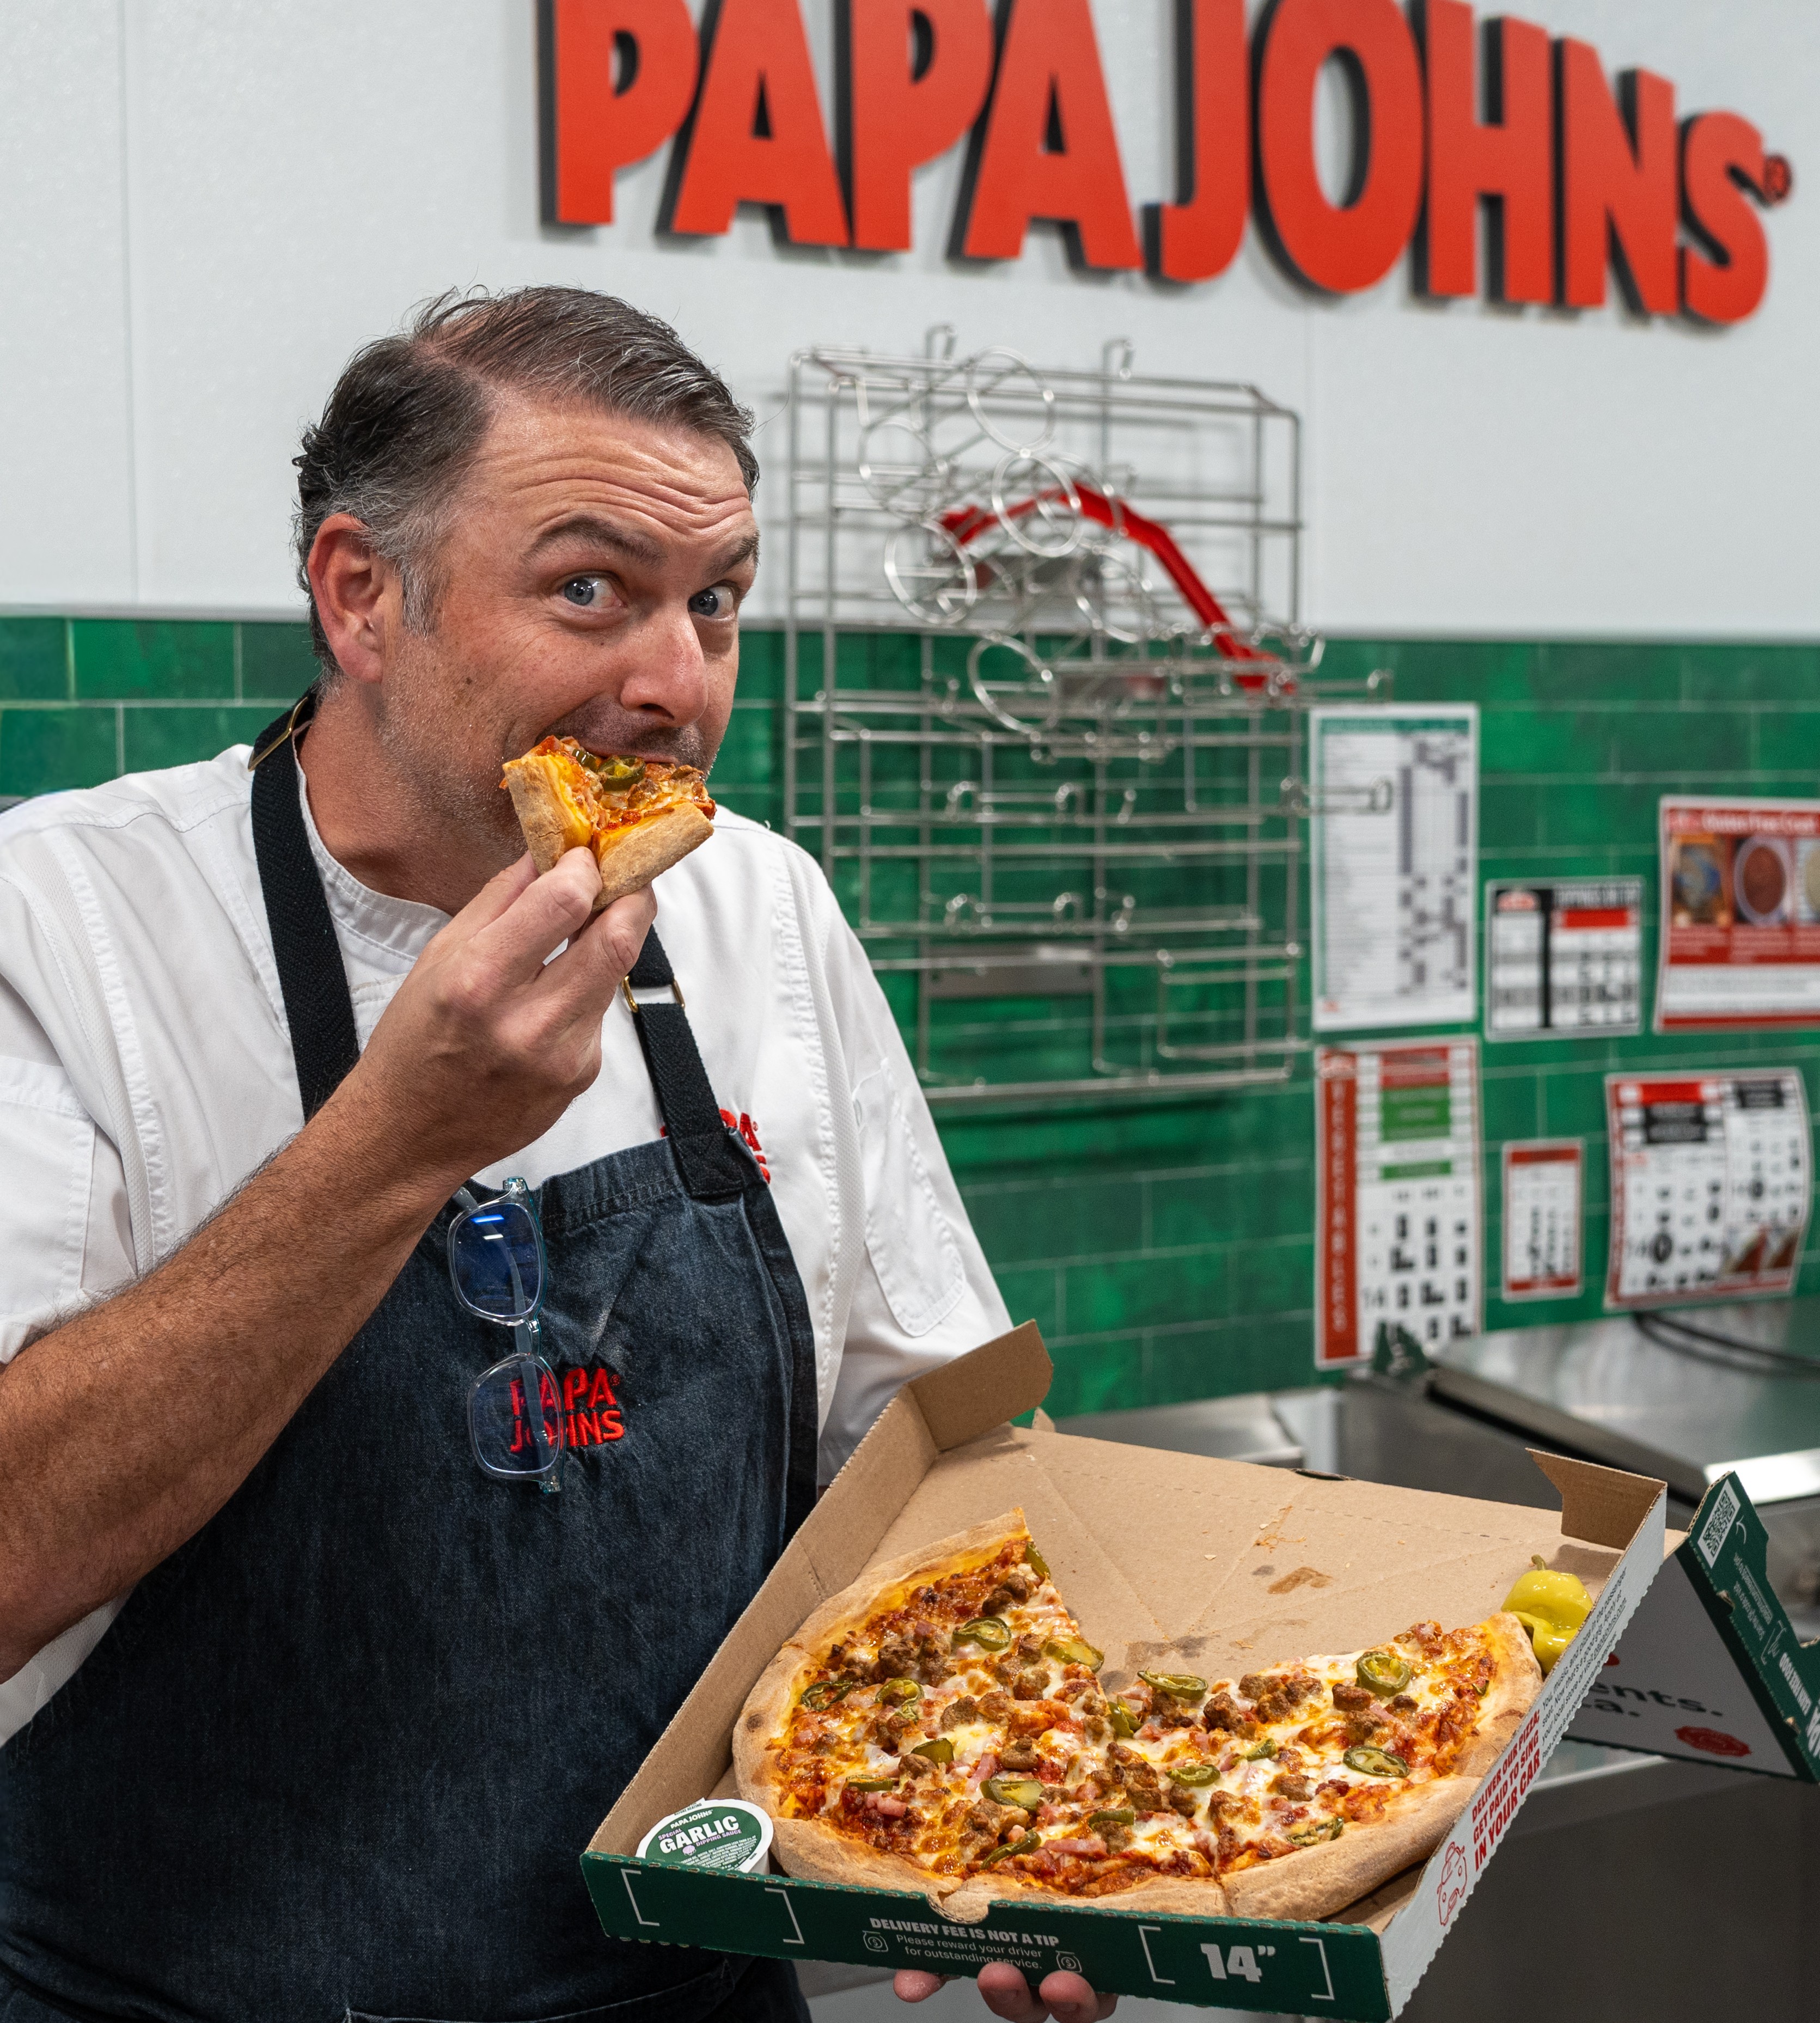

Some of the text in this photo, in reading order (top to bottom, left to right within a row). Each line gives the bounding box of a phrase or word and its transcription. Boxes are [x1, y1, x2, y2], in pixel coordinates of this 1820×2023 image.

[547, 0, 1143, 271] PAPA
[1472, 1768, 1501, 1823] DELIVER
[1503, 1743, 1518, 1775] OUR
[1473, 1729, 1539, 1844] GET PAID TO SING
[1475, 1748, 1540, 1872] IN YOUR CAR
[658, 1828, 683, 1841] SPECIAL
[659, 1816, 740, 1854] GARLIC
[695, 1829, 742, 1847] DIPPING SAUCE
[869, 1917, 1059, 1947] DELIVERY FEE IS NOT A TIP
[896, 1934, 1042, 1958] Please reward your driver
[905, 1946, 921, 1955] for
